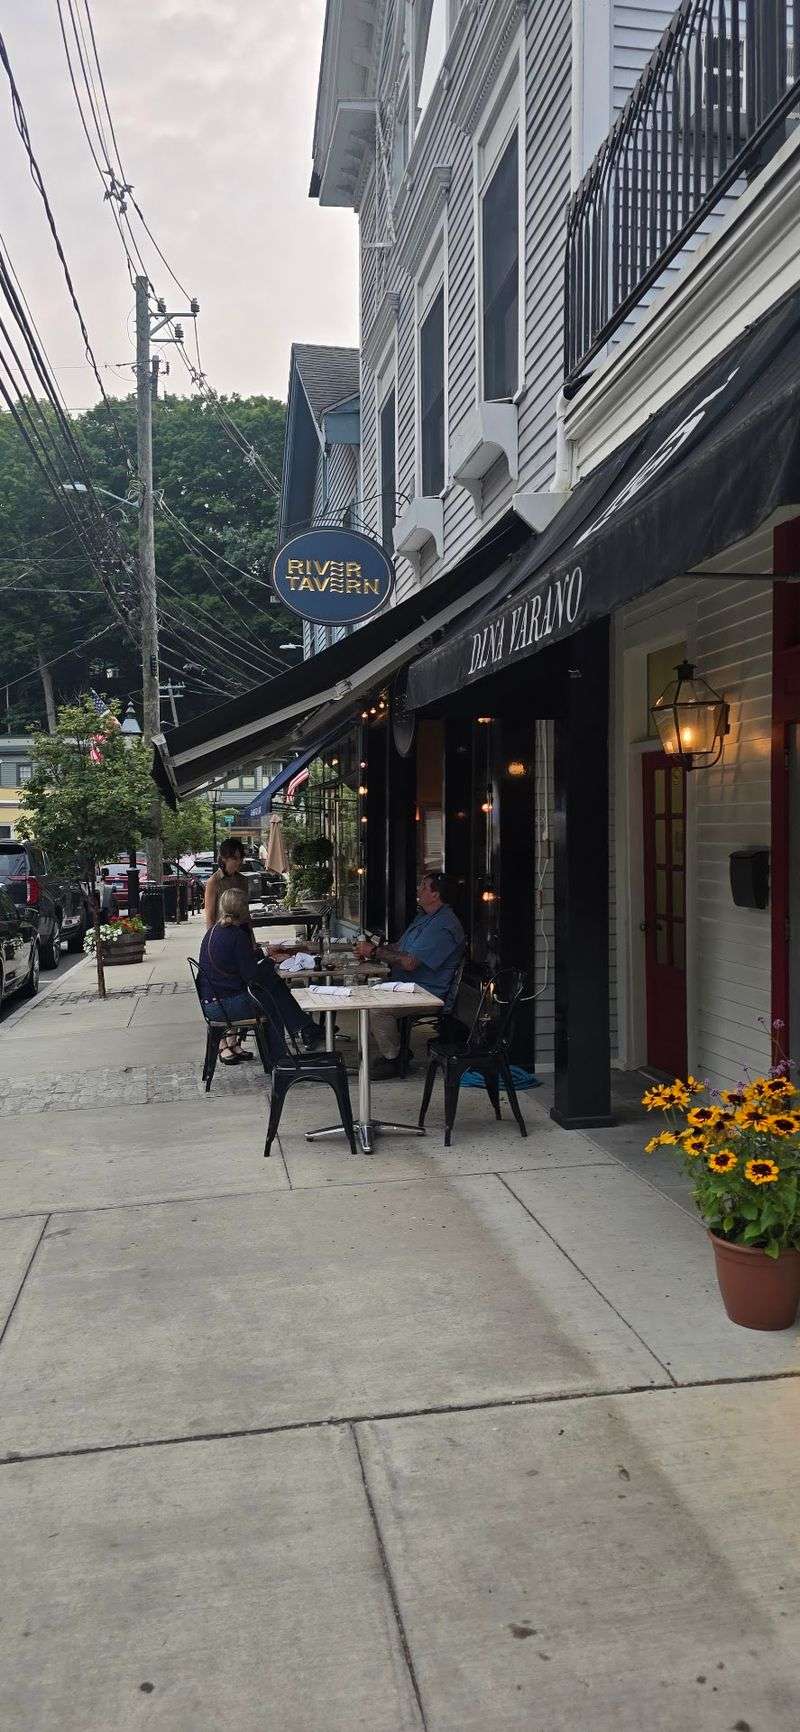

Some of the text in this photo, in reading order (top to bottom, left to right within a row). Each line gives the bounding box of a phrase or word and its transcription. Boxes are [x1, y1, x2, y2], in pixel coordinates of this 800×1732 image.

[287, 559, 362, 577] RIVER
[285, 576, 380, 595] TAVERN
[468, 566, 583, 675] DINA VARANO
